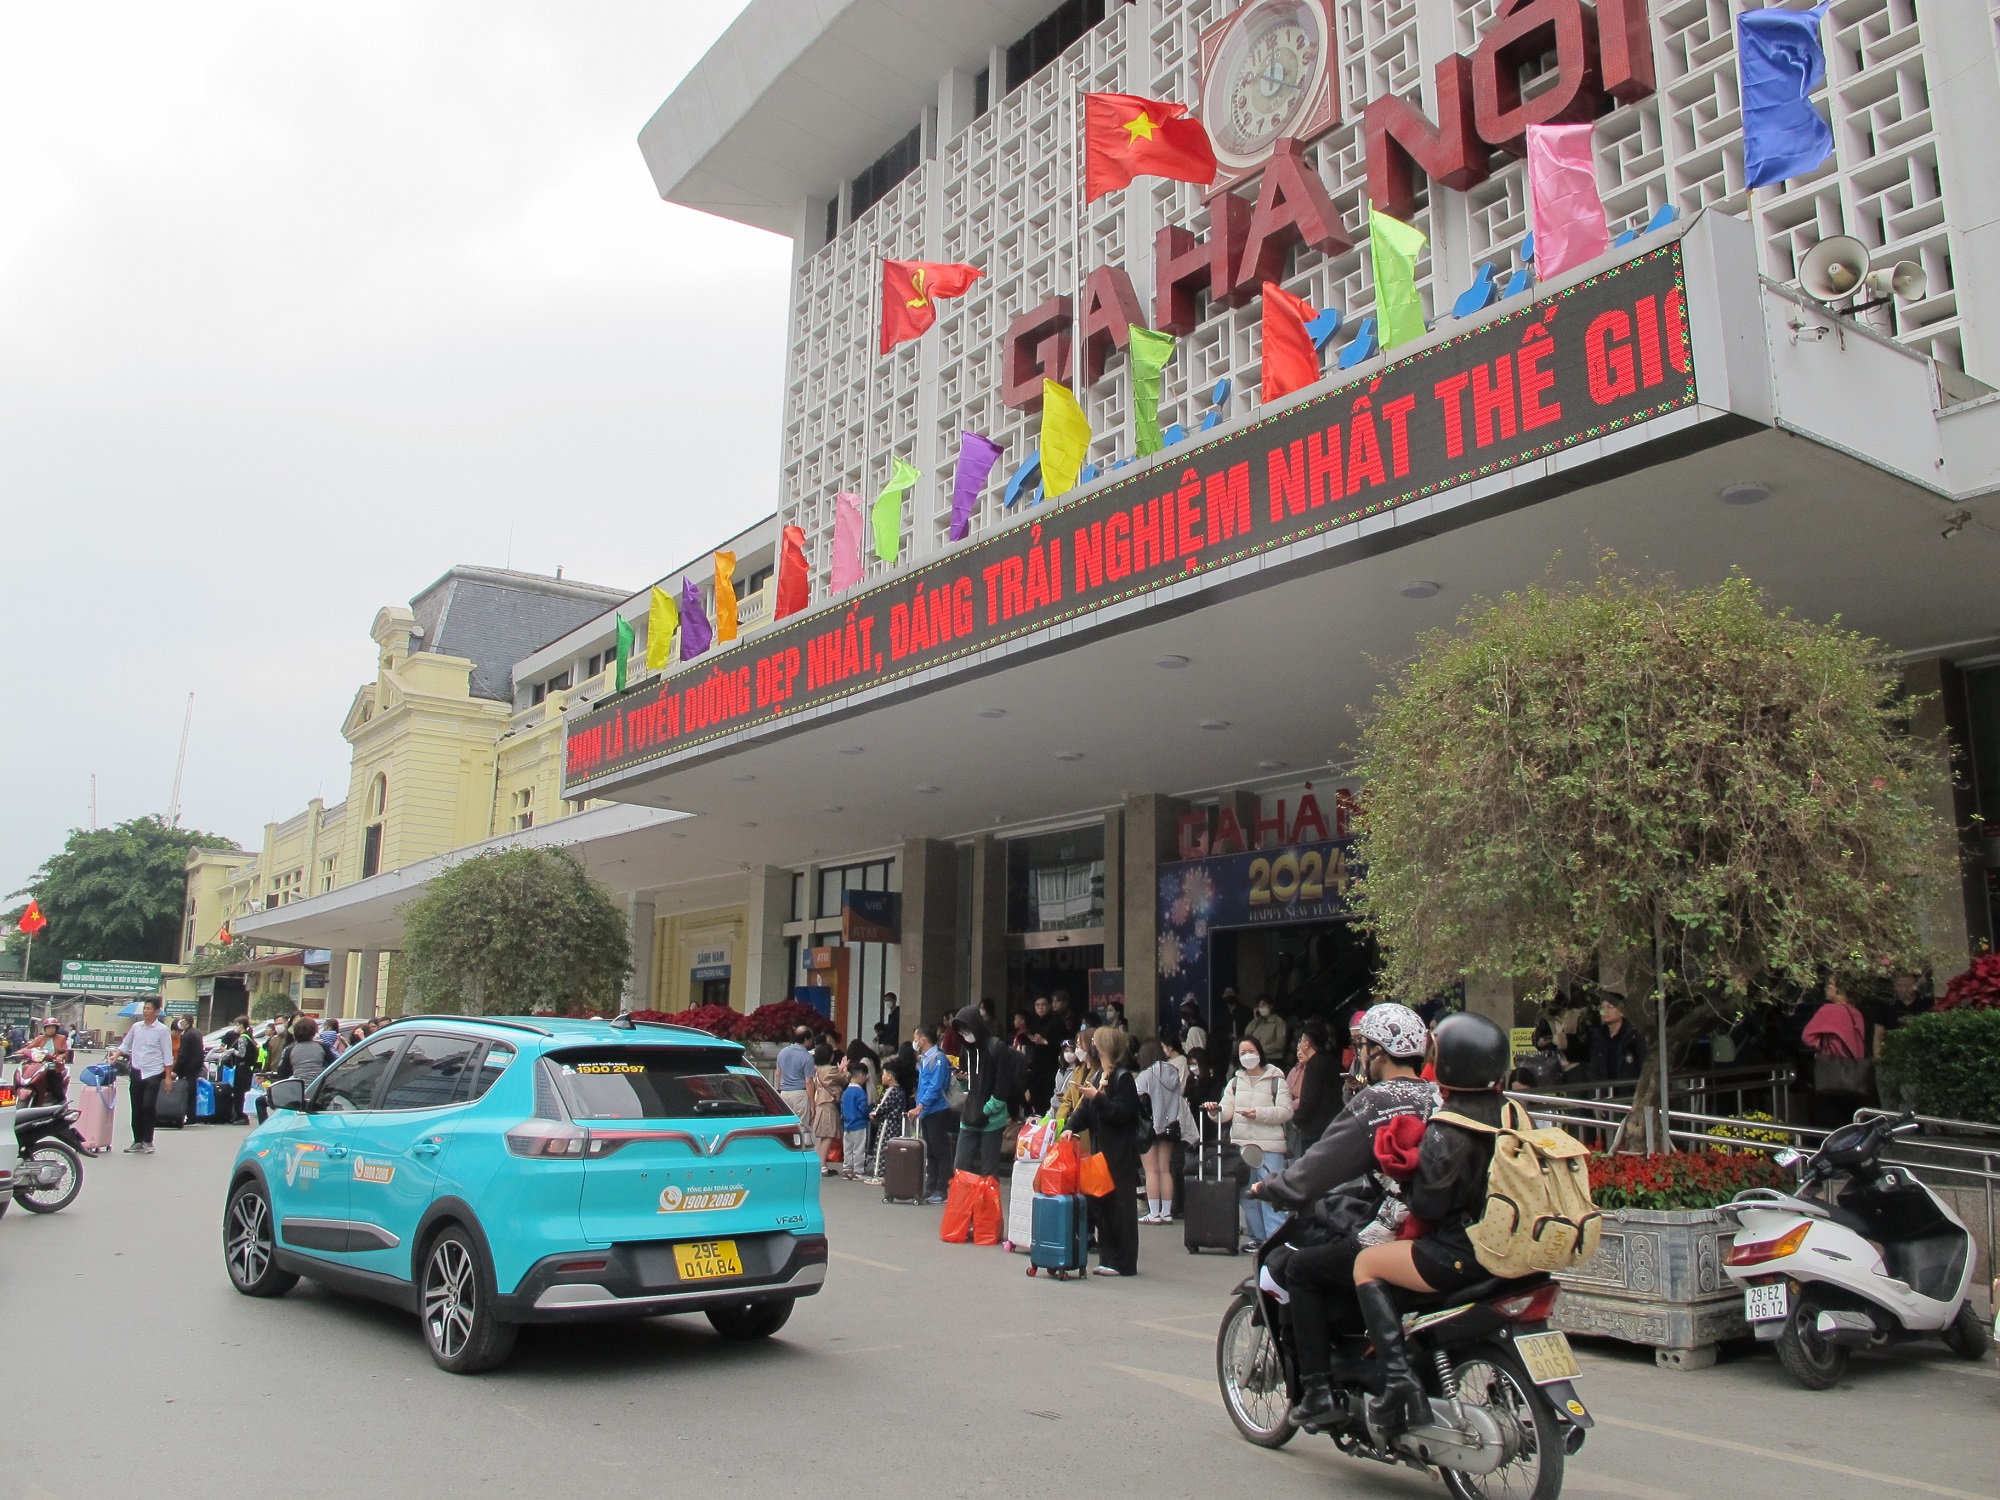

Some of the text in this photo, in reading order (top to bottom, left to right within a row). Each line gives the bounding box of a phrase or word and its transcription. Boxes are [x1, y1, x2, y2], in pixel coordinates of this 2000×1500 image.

[1271, 113, 1281, 127] 6
[1002, 264, 1147, 413] GA
[605, 709, 623, 761] LÀ
[627, 683, 680, 752] TUYẾN
[756, 646, 801, 714] ĐẸP
[807, 601, 883, 691] NHẤT,
[890, 576, 973, 661] ĐÁNG
[982, 525, 1062, 626] TRẢI
[1074, 461, 1251, 594] NGHIỆM
[1267, 377, 1415, 523] NHẤT
[1434, 305, 1561, 459] THẾ
[1178, 807, 1248, 860] GA
[1249, 848, 1349, 905] 2024
[1250, 903, 1340, 920] HAPPY NEW YEAR
[577, 1065, 645, 1073] 1900 2097
[682, 1193, 737, 1209] 1900 2088
[692, 1242, 721, 1260] 29E
[685, 1258, 736, 1277] 014.84
[1749, 1301, 1783, 1318] 196.12
